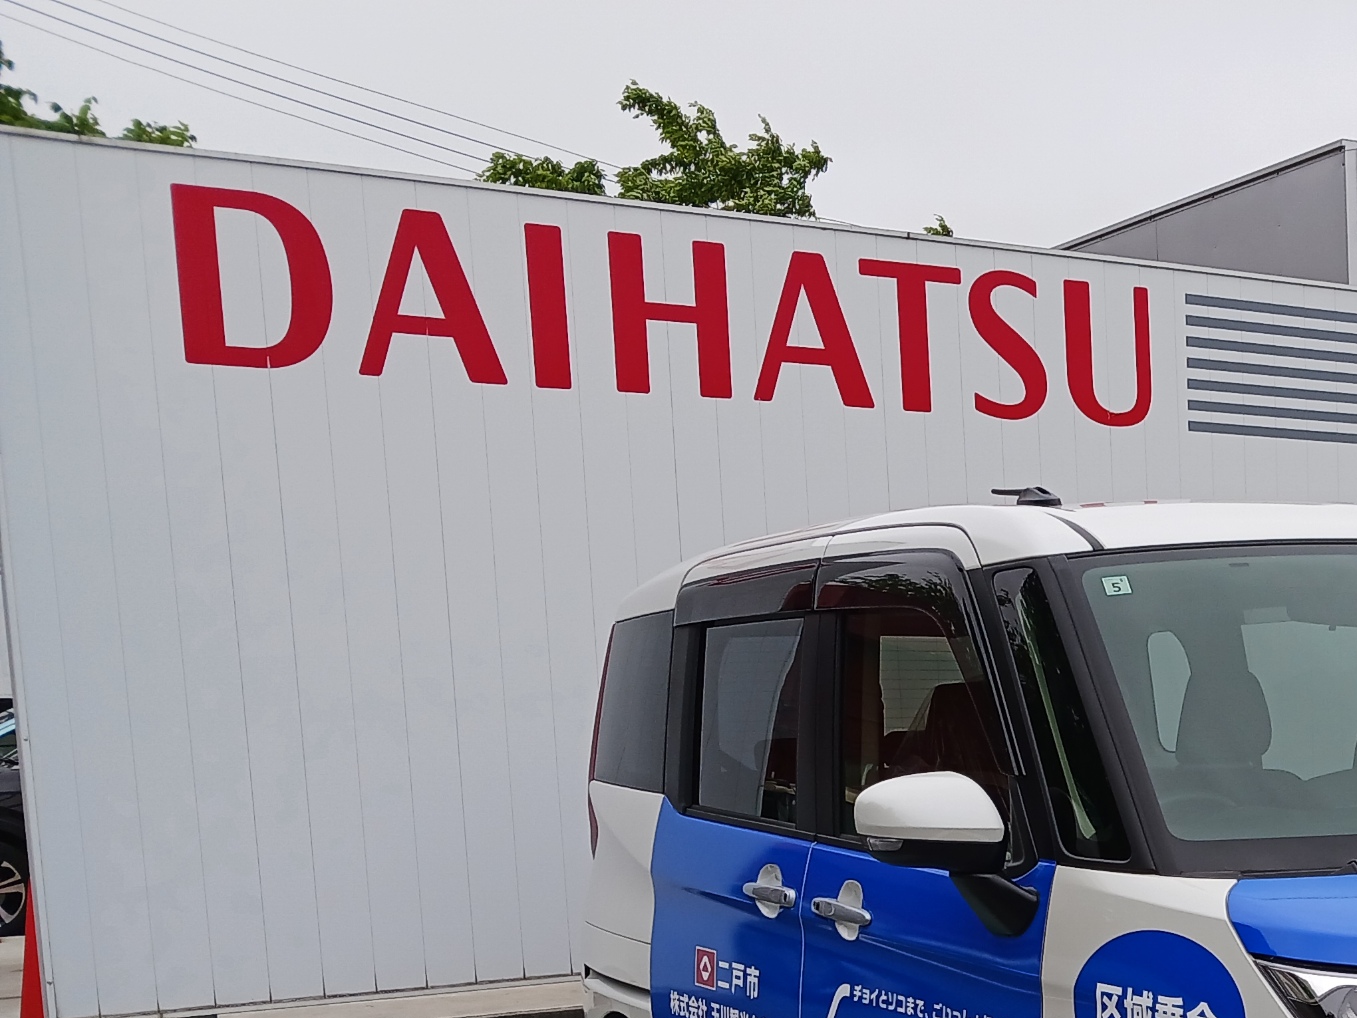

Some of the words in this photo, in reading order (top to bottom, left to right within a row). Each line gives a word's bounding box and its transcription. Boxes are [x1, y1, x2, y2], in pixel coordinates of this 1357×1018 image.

[170, 183, 1153, 427] DAIHATSU
[1111, 582, 1122, 593] 5
[718, 961, 760, 999] 二戸市
